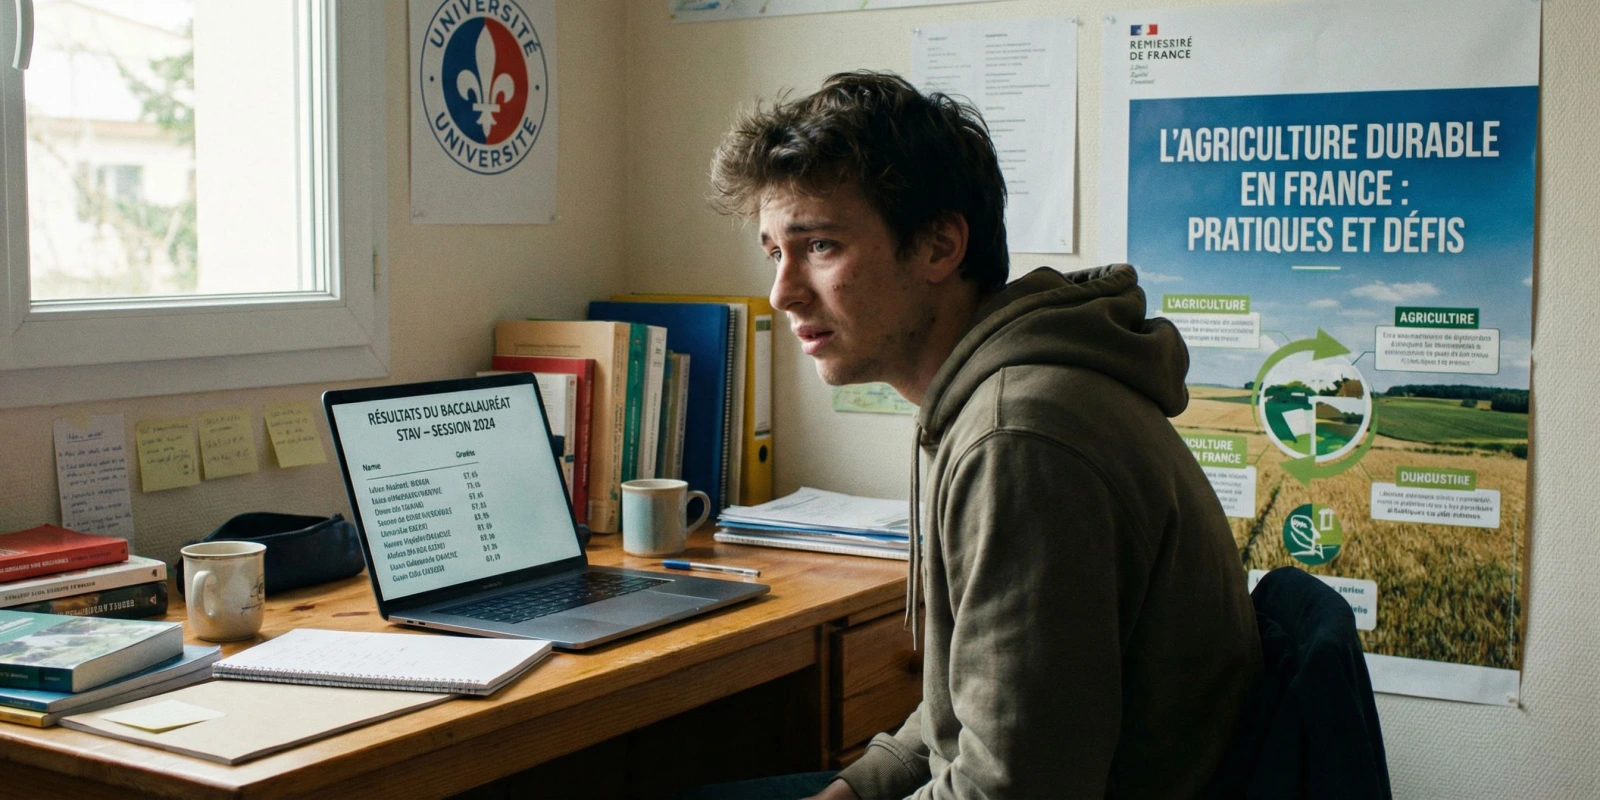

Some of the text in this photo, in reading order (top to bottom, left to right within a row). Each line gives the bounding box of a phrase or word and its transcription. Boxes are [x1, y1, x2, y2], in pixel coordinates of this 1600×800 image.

[430, 0, 540, 57] UNIVERSITÉ
[1130, 50, 1191, 60] DE FRANCE
[435, 112, 537, 167] UNIVERSITE
[1159, 121, 1500, 163] L’AGRICULTURE DURABLE
[1241, 171, 1275, 206] EN
[1284, 170, 1392, 206] FRANCE
[1188, 210, 1465, 254] PRATIQUES ET DÉFIS
[1399, 311, 1475, 325] AGRICULTIRE
[368, 395, 511, 425] RÉSULTATS DU BACCALAURÉAT
[396, 427, 421, 441] STAV
[432, 421, 471, 437] SESSION
[473, 417, 496, 431] 2024
[1202, 451, 1242, 464] FRANCE
